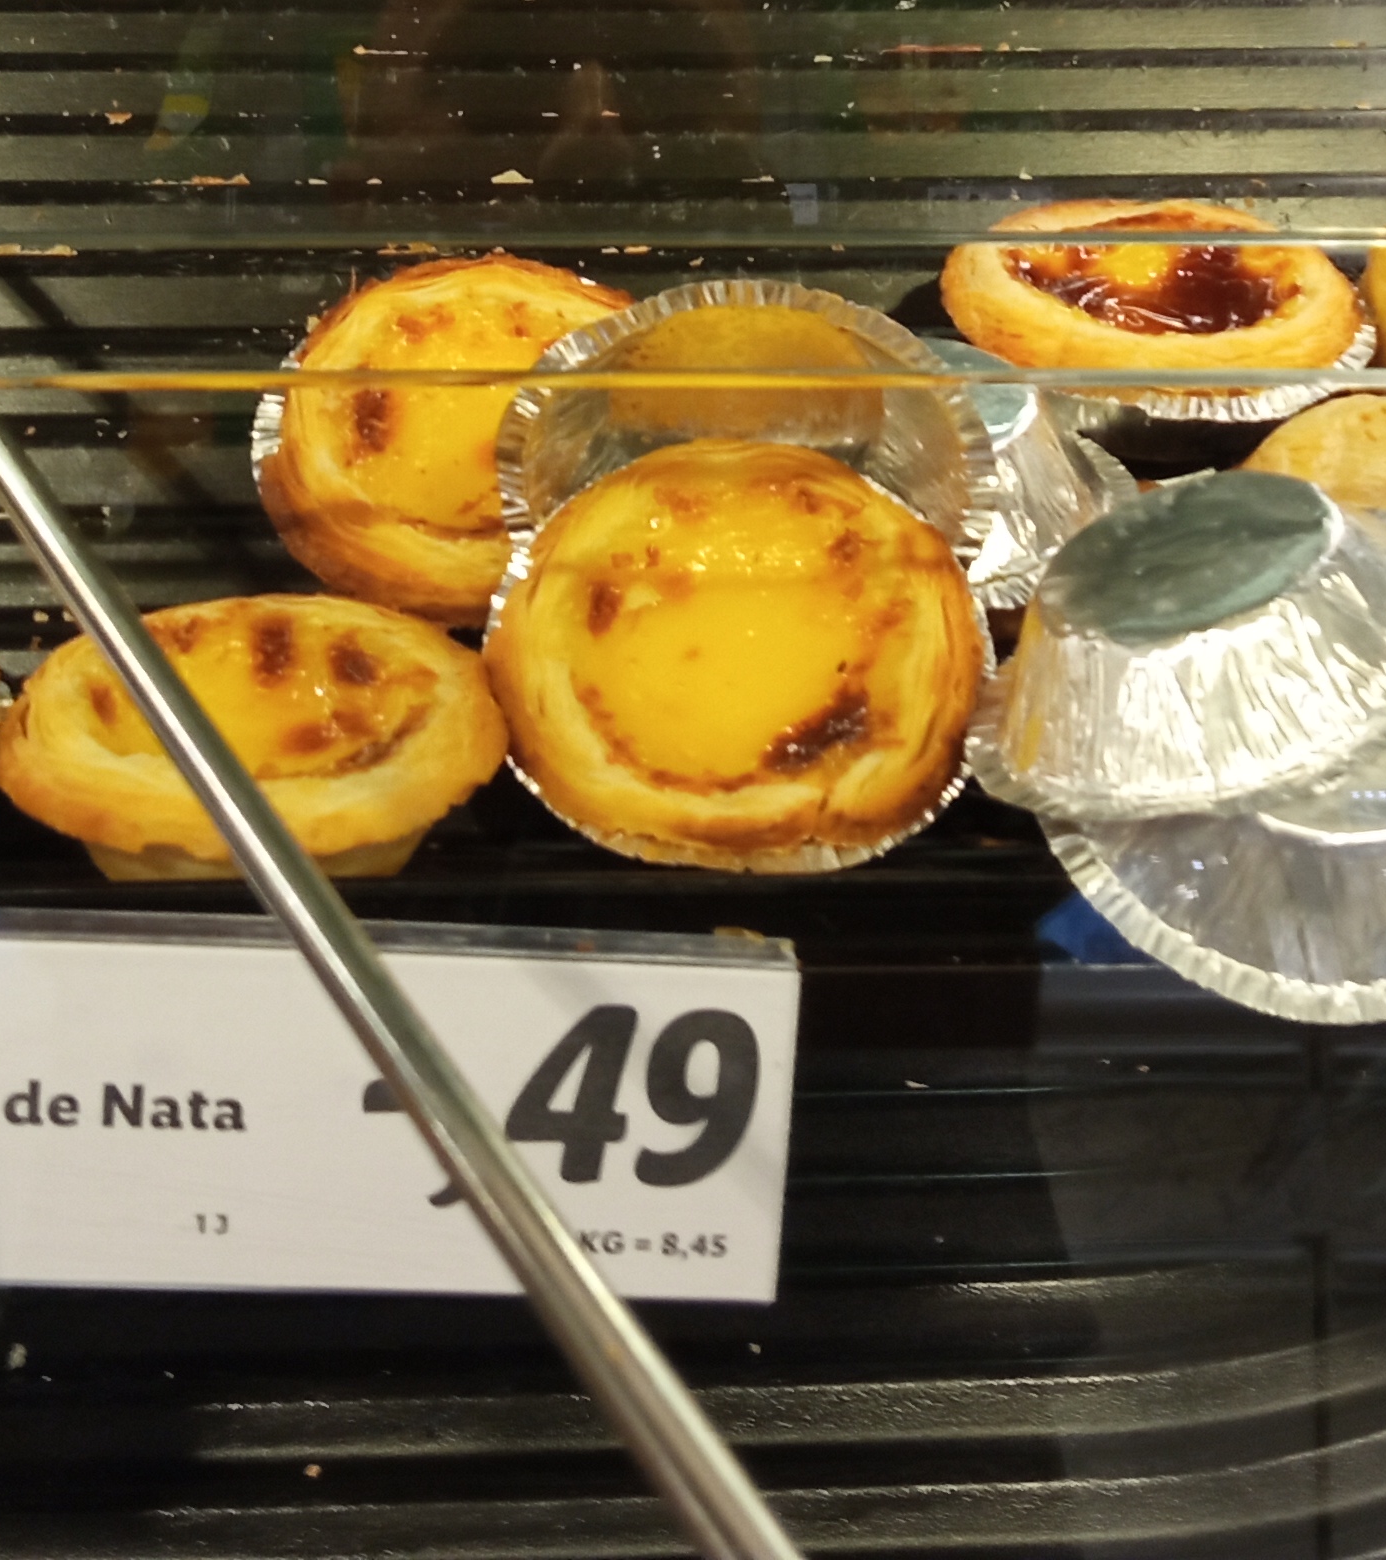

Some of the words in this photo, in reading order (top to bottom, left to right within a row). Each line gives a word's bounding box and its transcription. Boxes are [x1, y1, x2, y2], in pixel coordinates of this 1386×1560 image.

[4, 1080, 79, 1126] de
[101, 1083, 246, 1131] Nata
[660, 1233, 727, 1259] 8,45
